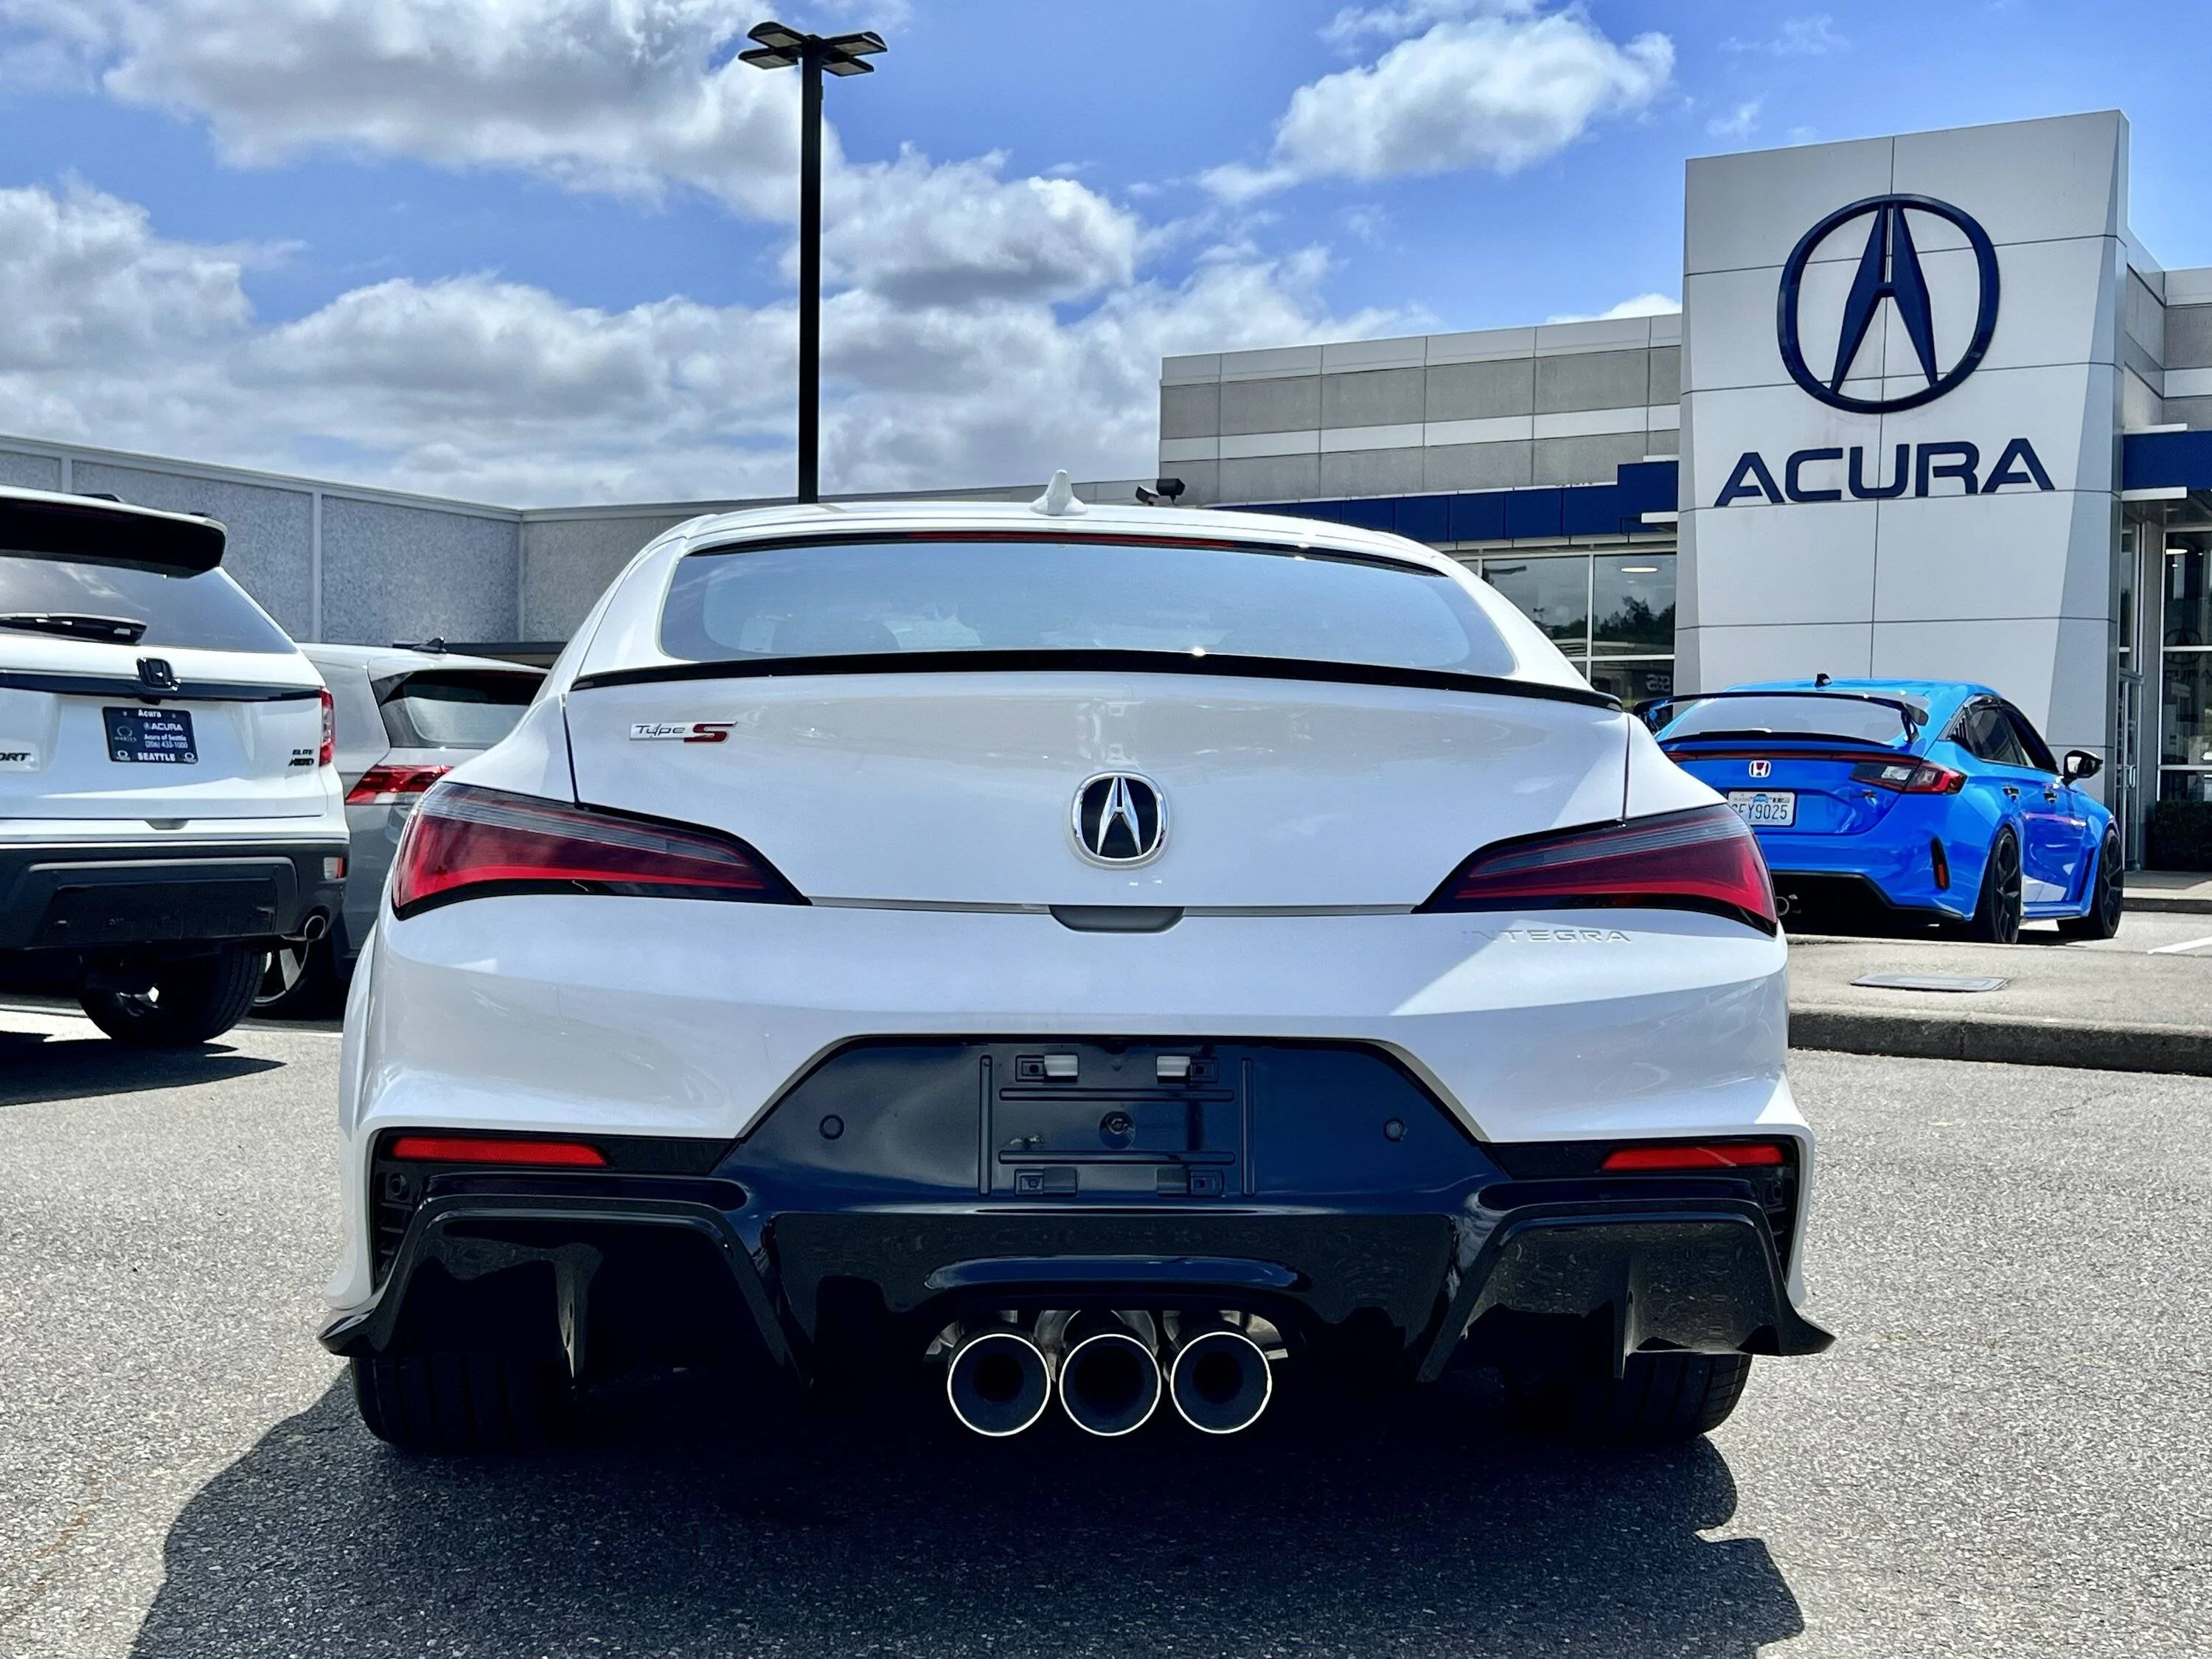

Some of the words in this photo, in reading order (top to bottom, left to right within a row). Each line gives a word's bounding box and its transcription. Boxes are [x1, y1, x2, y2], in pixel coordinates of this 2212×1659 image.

[1714, 437, 2056, 507] ACURA
[138, 709, 161, 718] Acura
[150, 723, 183, 731] ACURA
[636, 723, 686, 737] Type
[684, 723, 737, 742] S
[137, 752, 175, 762] SEATTLE
[1732, 803, 1788, 820] FY9025
[1461, 929, 1632, 943] INTEGRA
